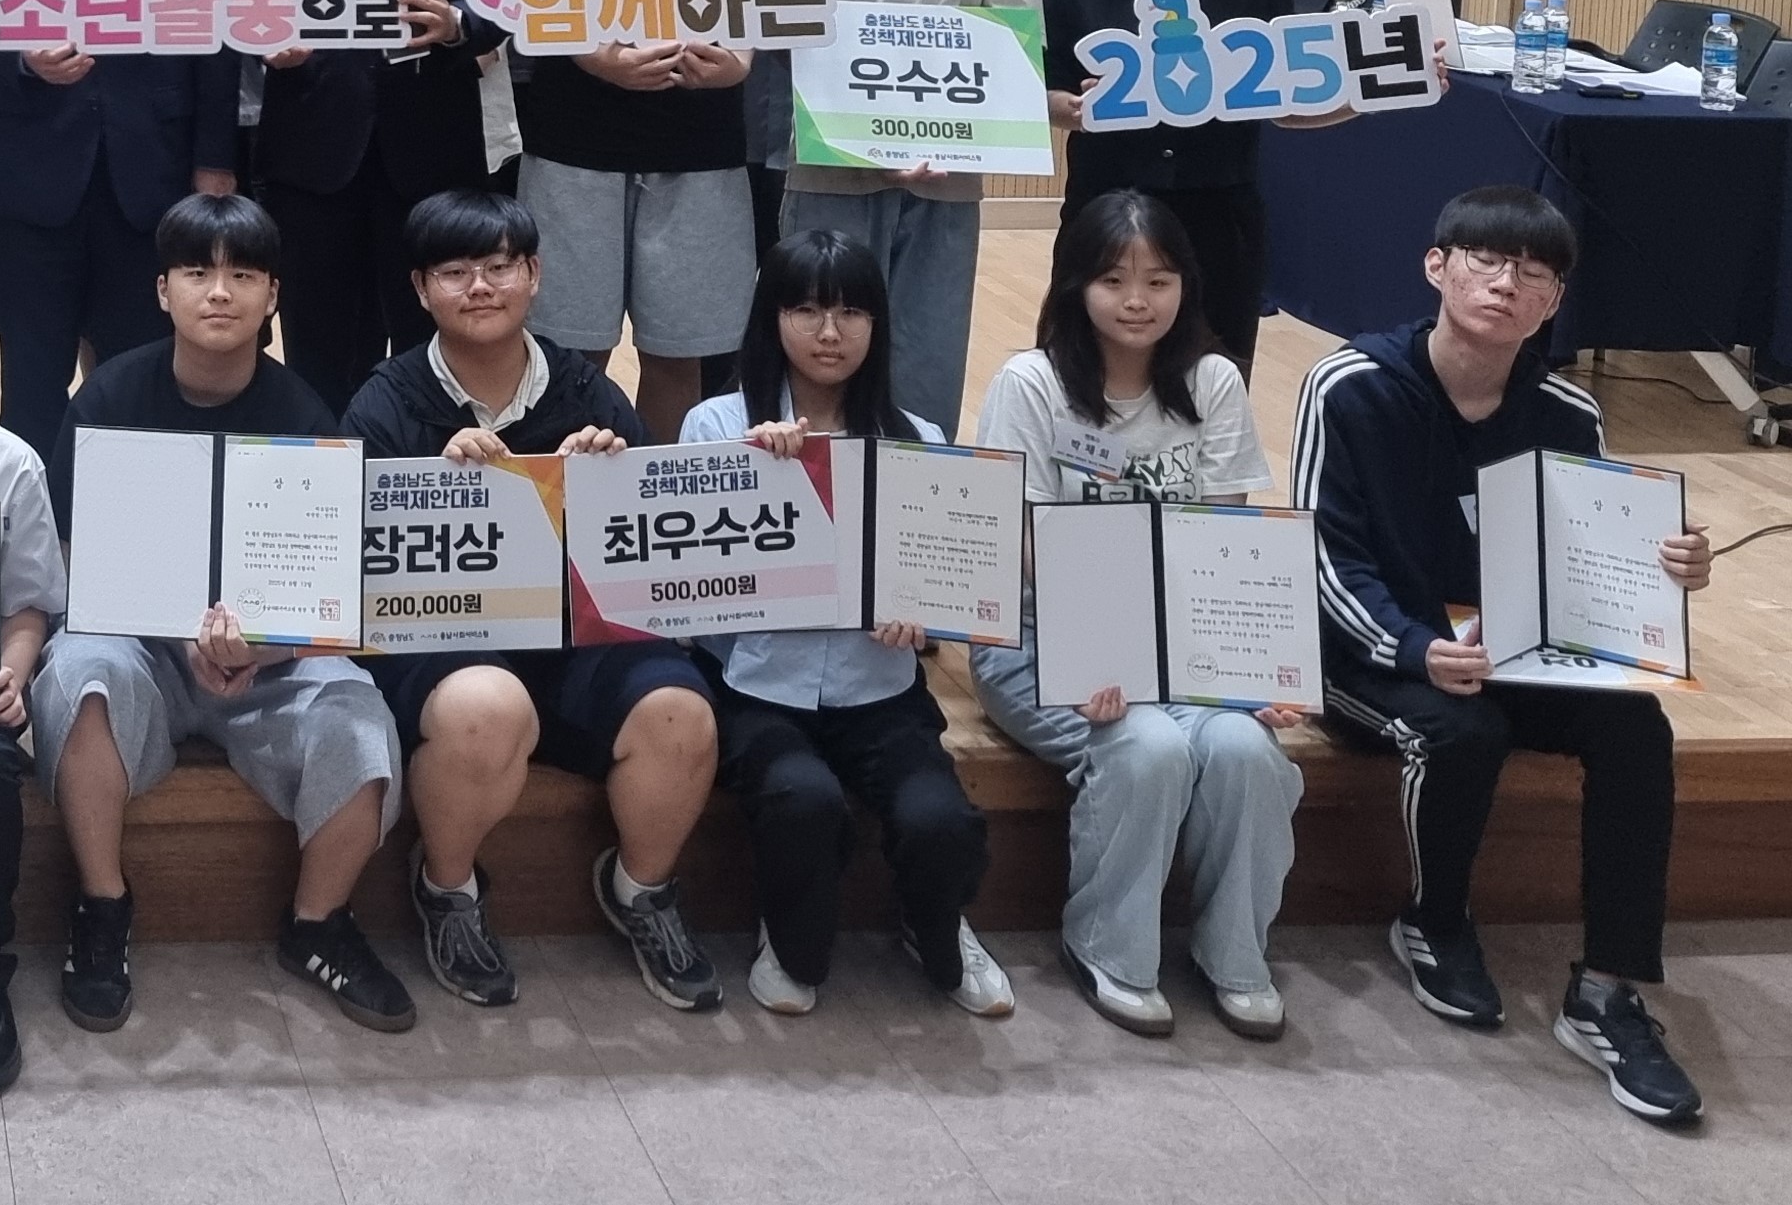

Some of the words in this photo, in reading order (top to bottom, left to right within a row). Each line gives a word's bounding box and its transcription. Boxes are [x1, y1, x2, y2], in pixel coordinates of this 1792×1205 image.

[865, 13, 919, 29] 충청남도
[922, 15, 964, 31] 청소년
[858, 28, 972, 50] 정책제안대회
[1086, 11, 1429, 122] 2025년
[849, 57, 990, 104] 우수상
[871, 118, 973, 140] 300,000원
[646, 457, 704, 476] 충청남도
[707, 453, 750, 471] 청소년
[377, 472, 436, 489] 충청남도
[439, 471, 483, 487] 청소년
[638, 470, 759, 499] 정책제안대회
[369, 487, 489, 511] 정책제안대회
[604, 501, 800, 565] 최우수상
[364, 522, 504, 575] 장려상
[651, 574, 757, 602] 500,000원
[376, 593, 482, 618] 200,000원
